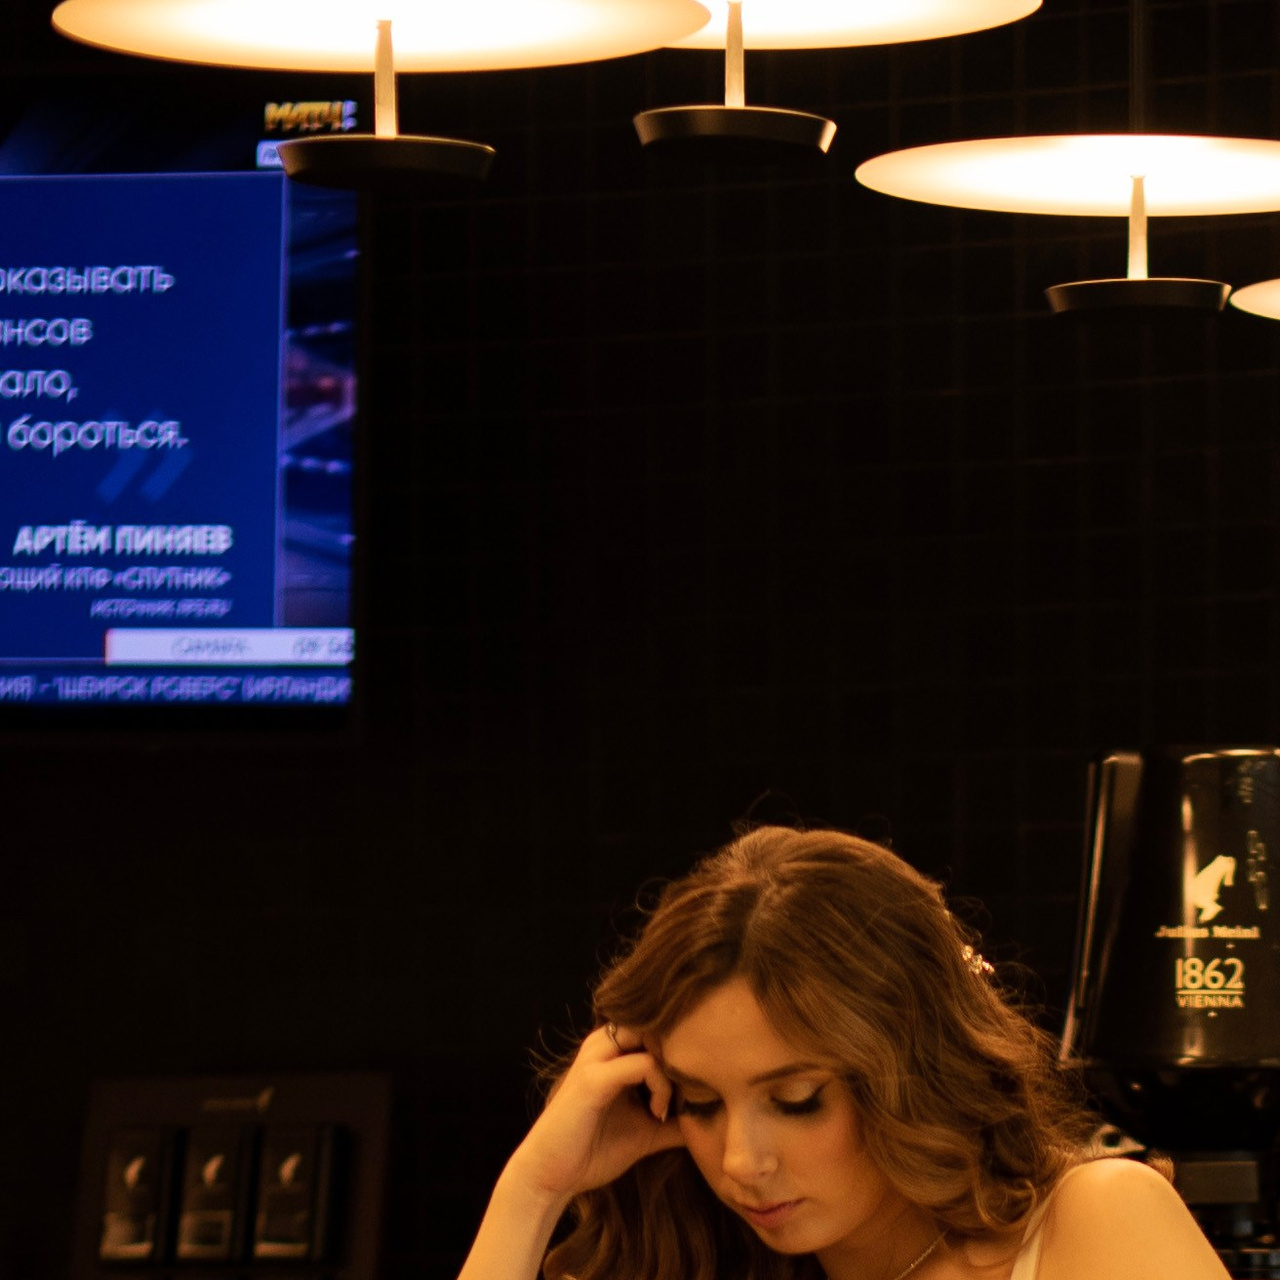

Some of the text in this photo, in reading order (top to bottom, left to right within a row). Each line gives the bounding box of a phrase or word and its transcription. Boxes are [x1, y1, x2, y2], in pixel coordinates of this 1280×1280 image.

[0, 266, 175, 294] казывать
[0, 318, 93, 345] нсов
[8, 413, 189, 456] бороться.
[13, 519, 113, 555] АРТЁМ
[1175, 957, 1245, 989] 1862
[1176, 995, 1245, 1008] VIENNA
